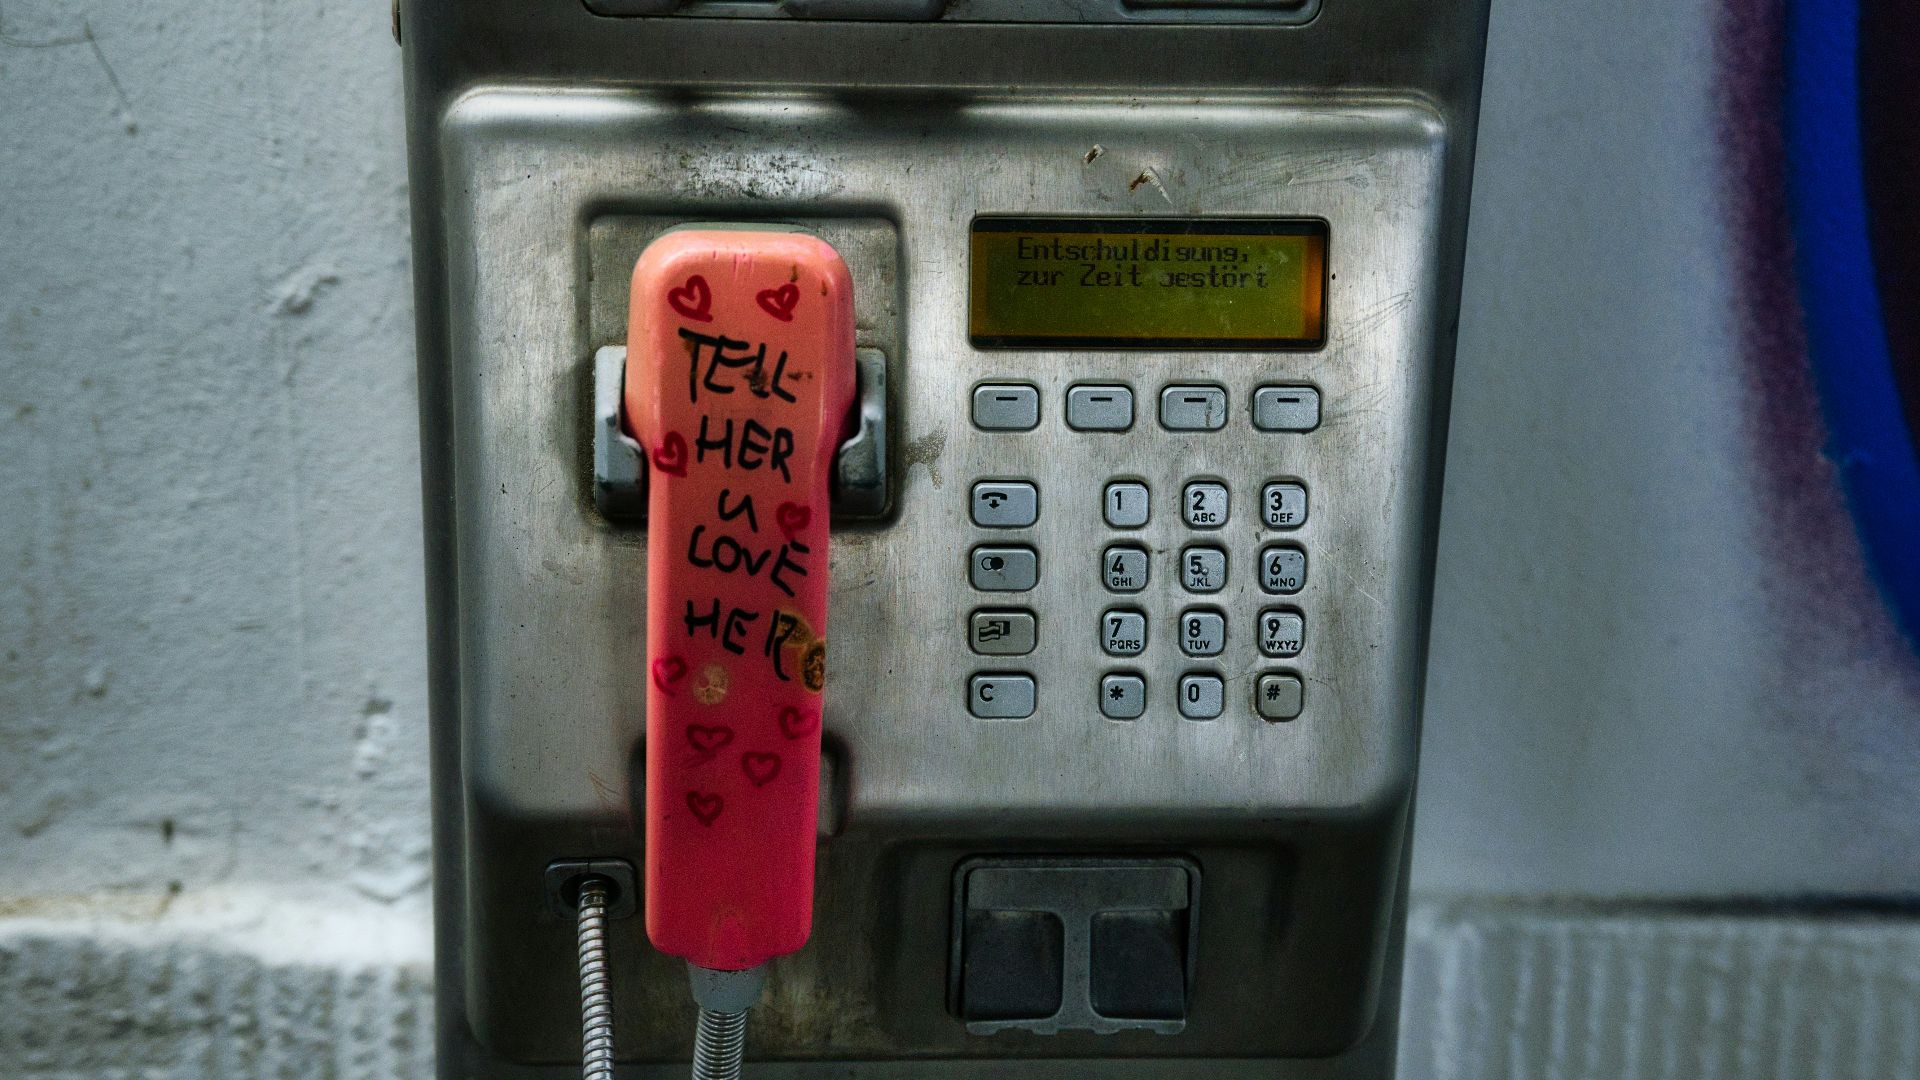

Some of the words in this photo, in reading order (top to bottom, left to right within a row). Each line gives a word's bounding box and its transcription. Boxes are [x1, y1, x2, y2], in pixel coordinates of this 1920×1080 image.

[1017, 236, 1249, 263] Entschuldigung,
[1017, 270, 1065, 287] zur
[1080, 263, 1143, 288] Zeit
[678, 326, 797, 405] TELL
[695, 414, 794, 484] HER
[1114, 490, 1122, 511] 1
[1192, 490, 1205, 511] 2
[1270, 490, 1283, 511] 3
[1191, 512, 1216, 523] ABC
[1270, 512, 1294, 523] DEF
[687, 524, 810, 598] LOVE
[1111, 555, 1125, 575] 4
[1189, 555, 1202, 575] 5
[1269, 556, 1282, 576] 6
[1111, 577, 1132, 587] GHI
[1189, 577, 1212, 587] JKL
[1269, 577, 1296, 587] MNO
[1109, 618, 1122, 638] 7
[1188, 618, 1201, 638] 8
[1267, 618, 1280, 639] 9
[684, 597, 800, 681] HER
[1109, 639, 1141, 650] PQRS
[1187, 639, 1211, 650] TUV
[1265, 639, 1299, 650] WXYZ
[979, 683, 994, 702] C
[1266, 684, 1281, 701] #
